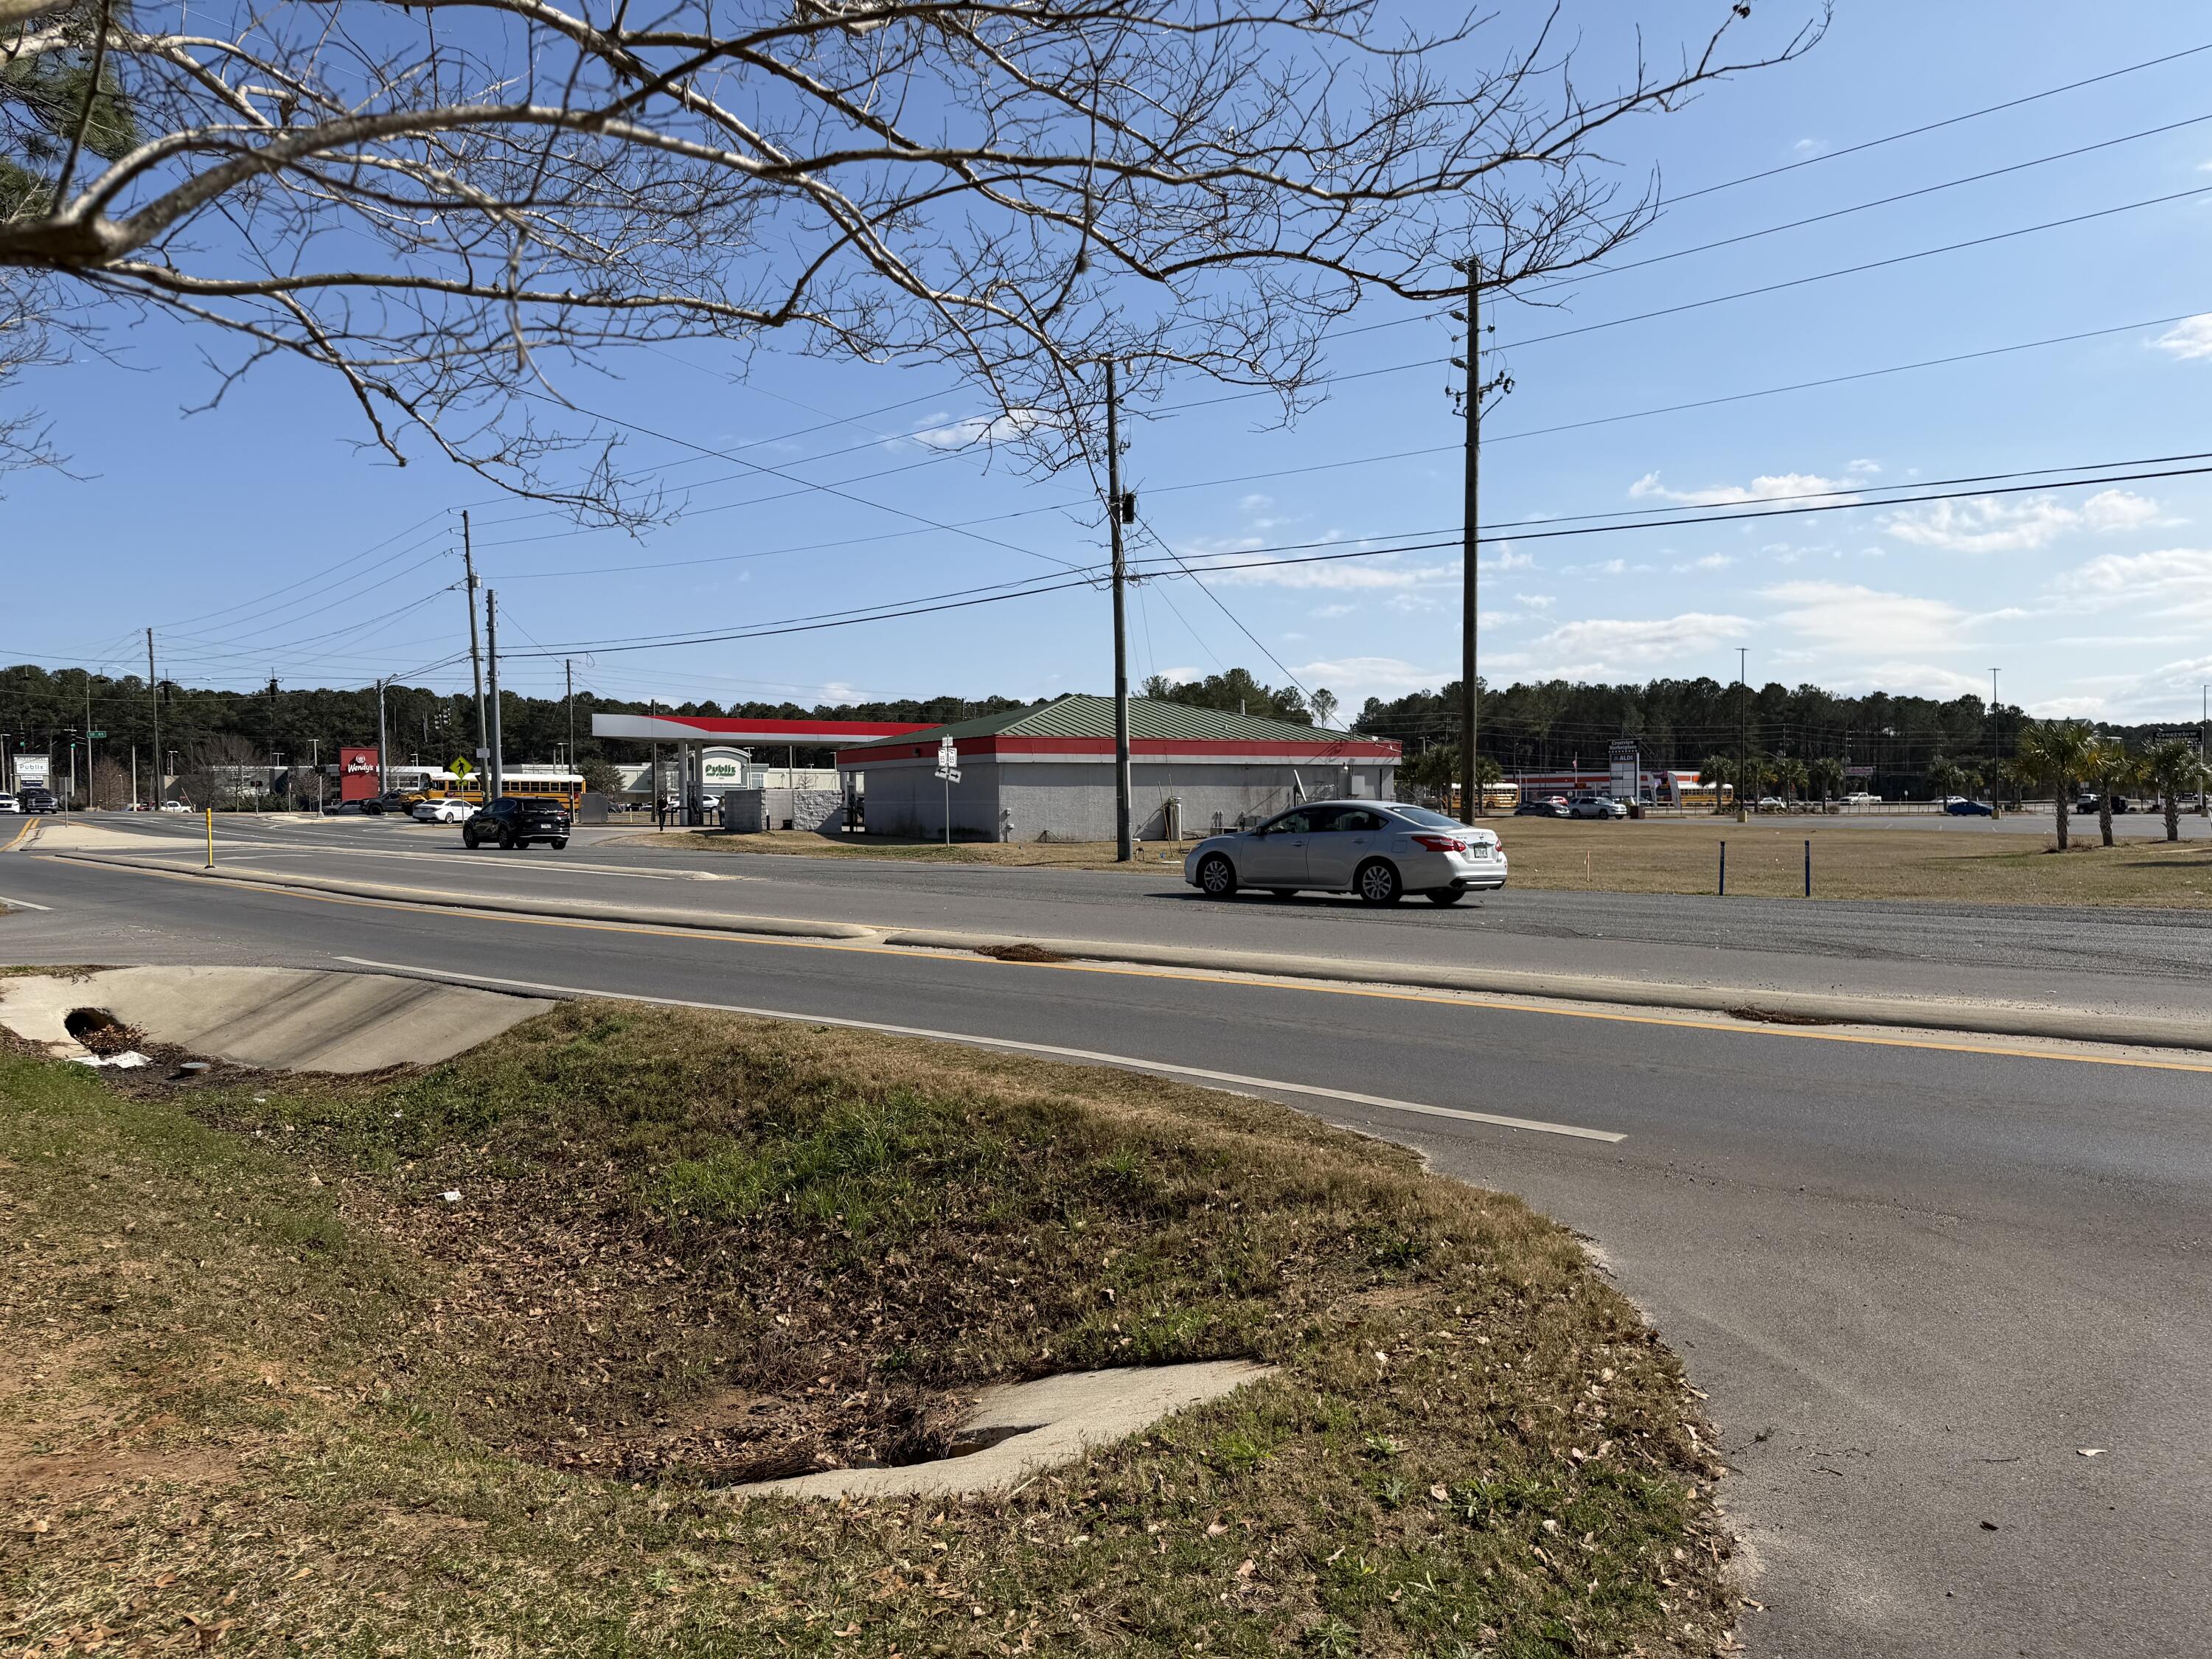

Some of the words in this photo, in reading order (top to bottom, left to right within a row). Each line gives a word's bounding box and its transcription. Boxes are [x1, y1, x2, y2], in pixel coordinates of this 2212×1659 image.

[949, 756, 955, 764] 85
[347, 762, 374, 773] Wendy's
[705, 764, 737, 773] Publix
